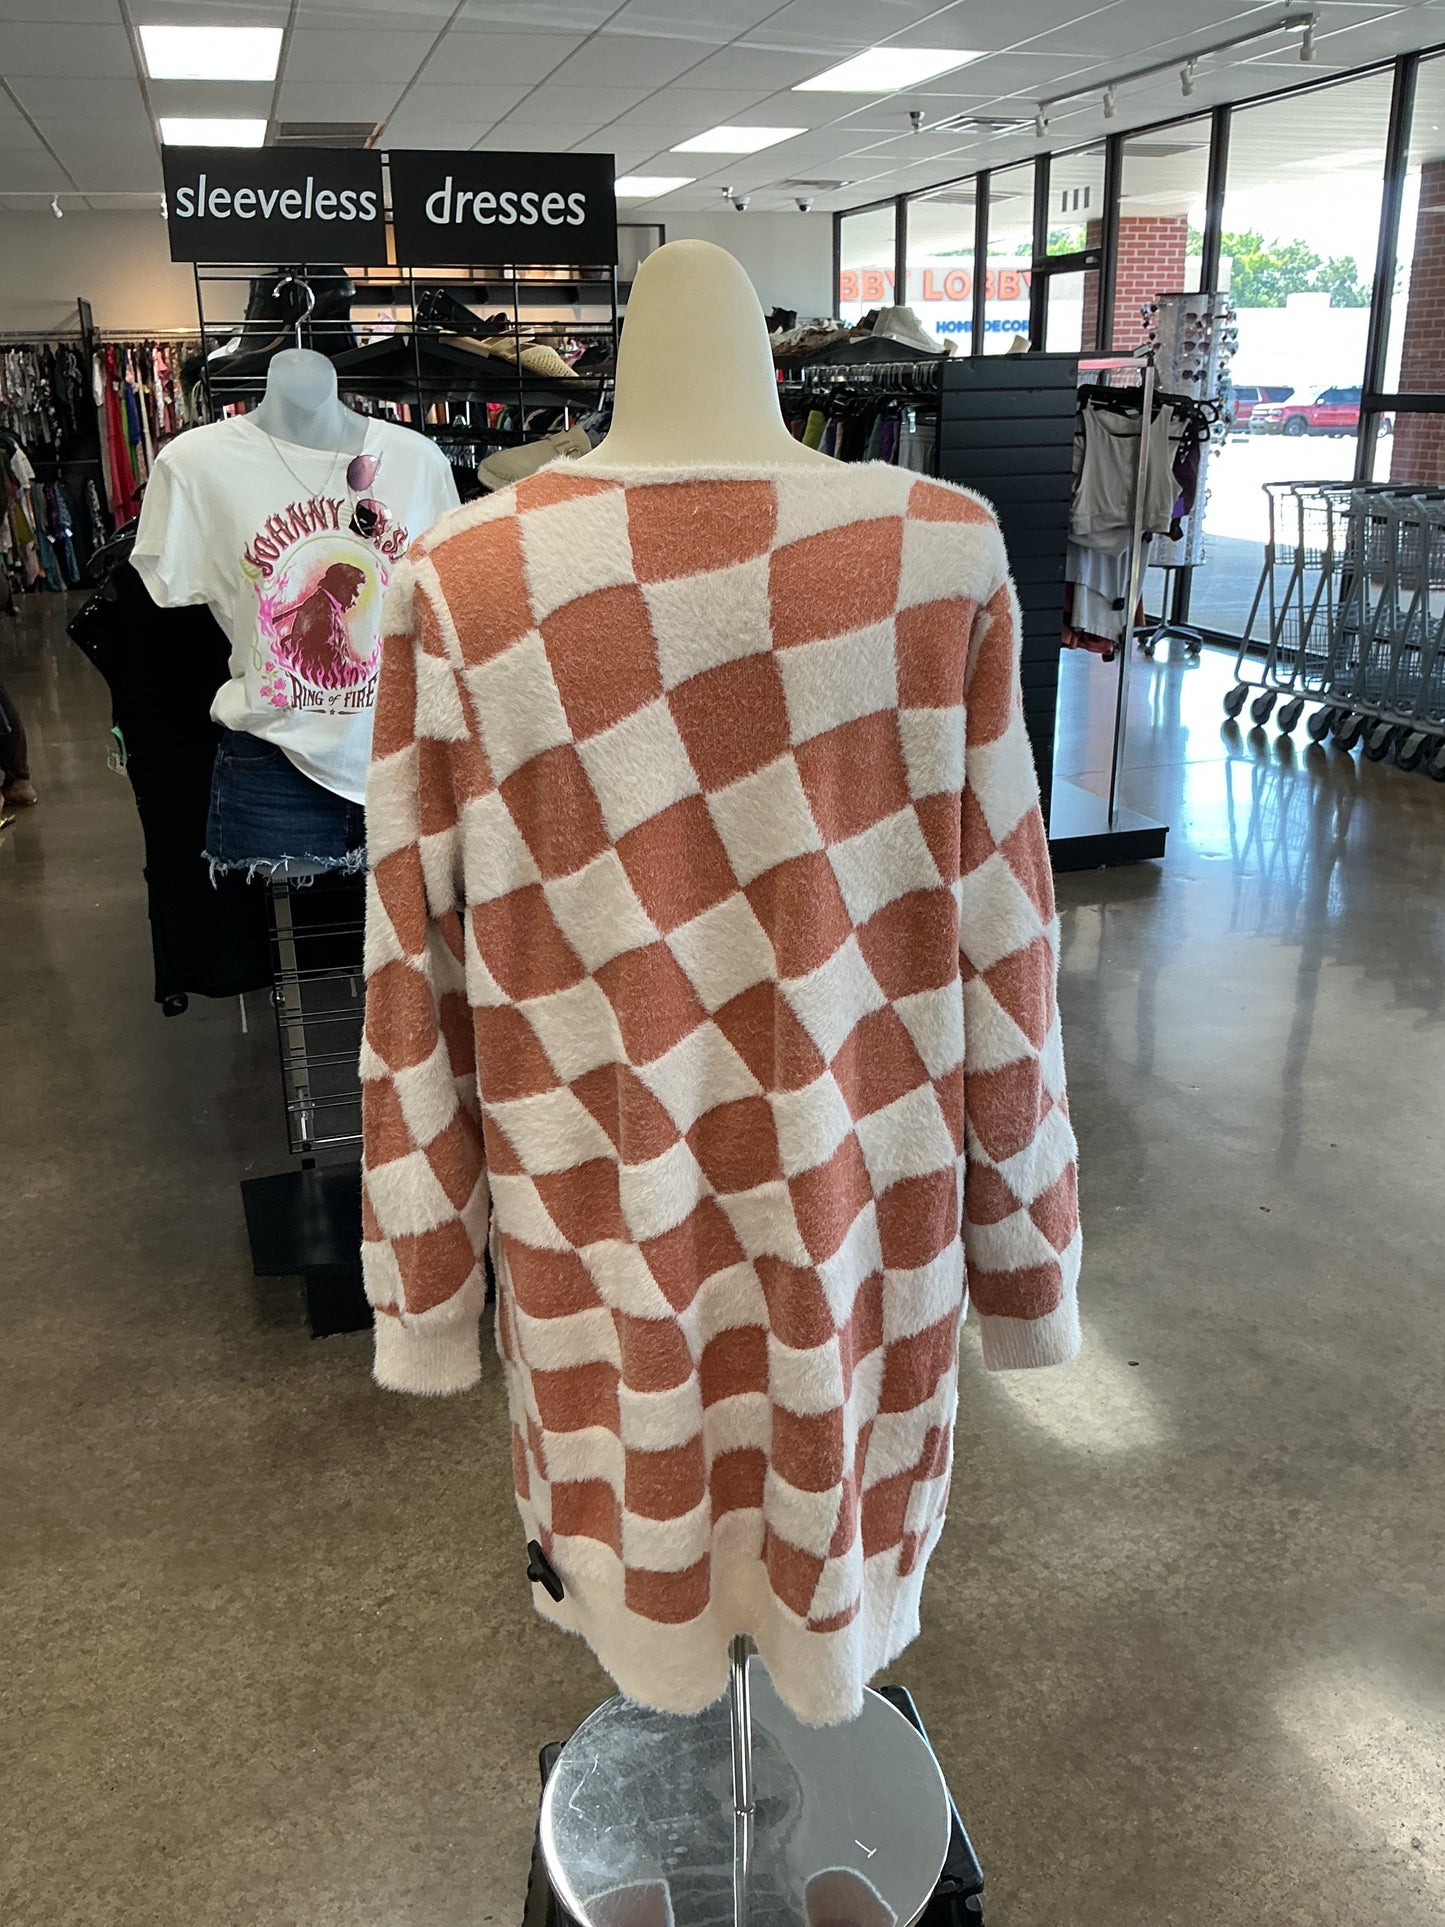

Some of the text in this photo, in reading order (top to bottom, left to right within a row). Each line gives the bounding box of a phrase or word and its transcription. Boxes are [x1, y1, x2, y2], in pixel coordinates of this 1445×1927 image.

[175, 174, 377, 221] sleeveless
[425, 176, 586, 226] dresses
[936, 320, 973, 334] HOM
[244, 496, 345, 577] JOHNNY
[284, 670, 379, 710] RING of FIRE
